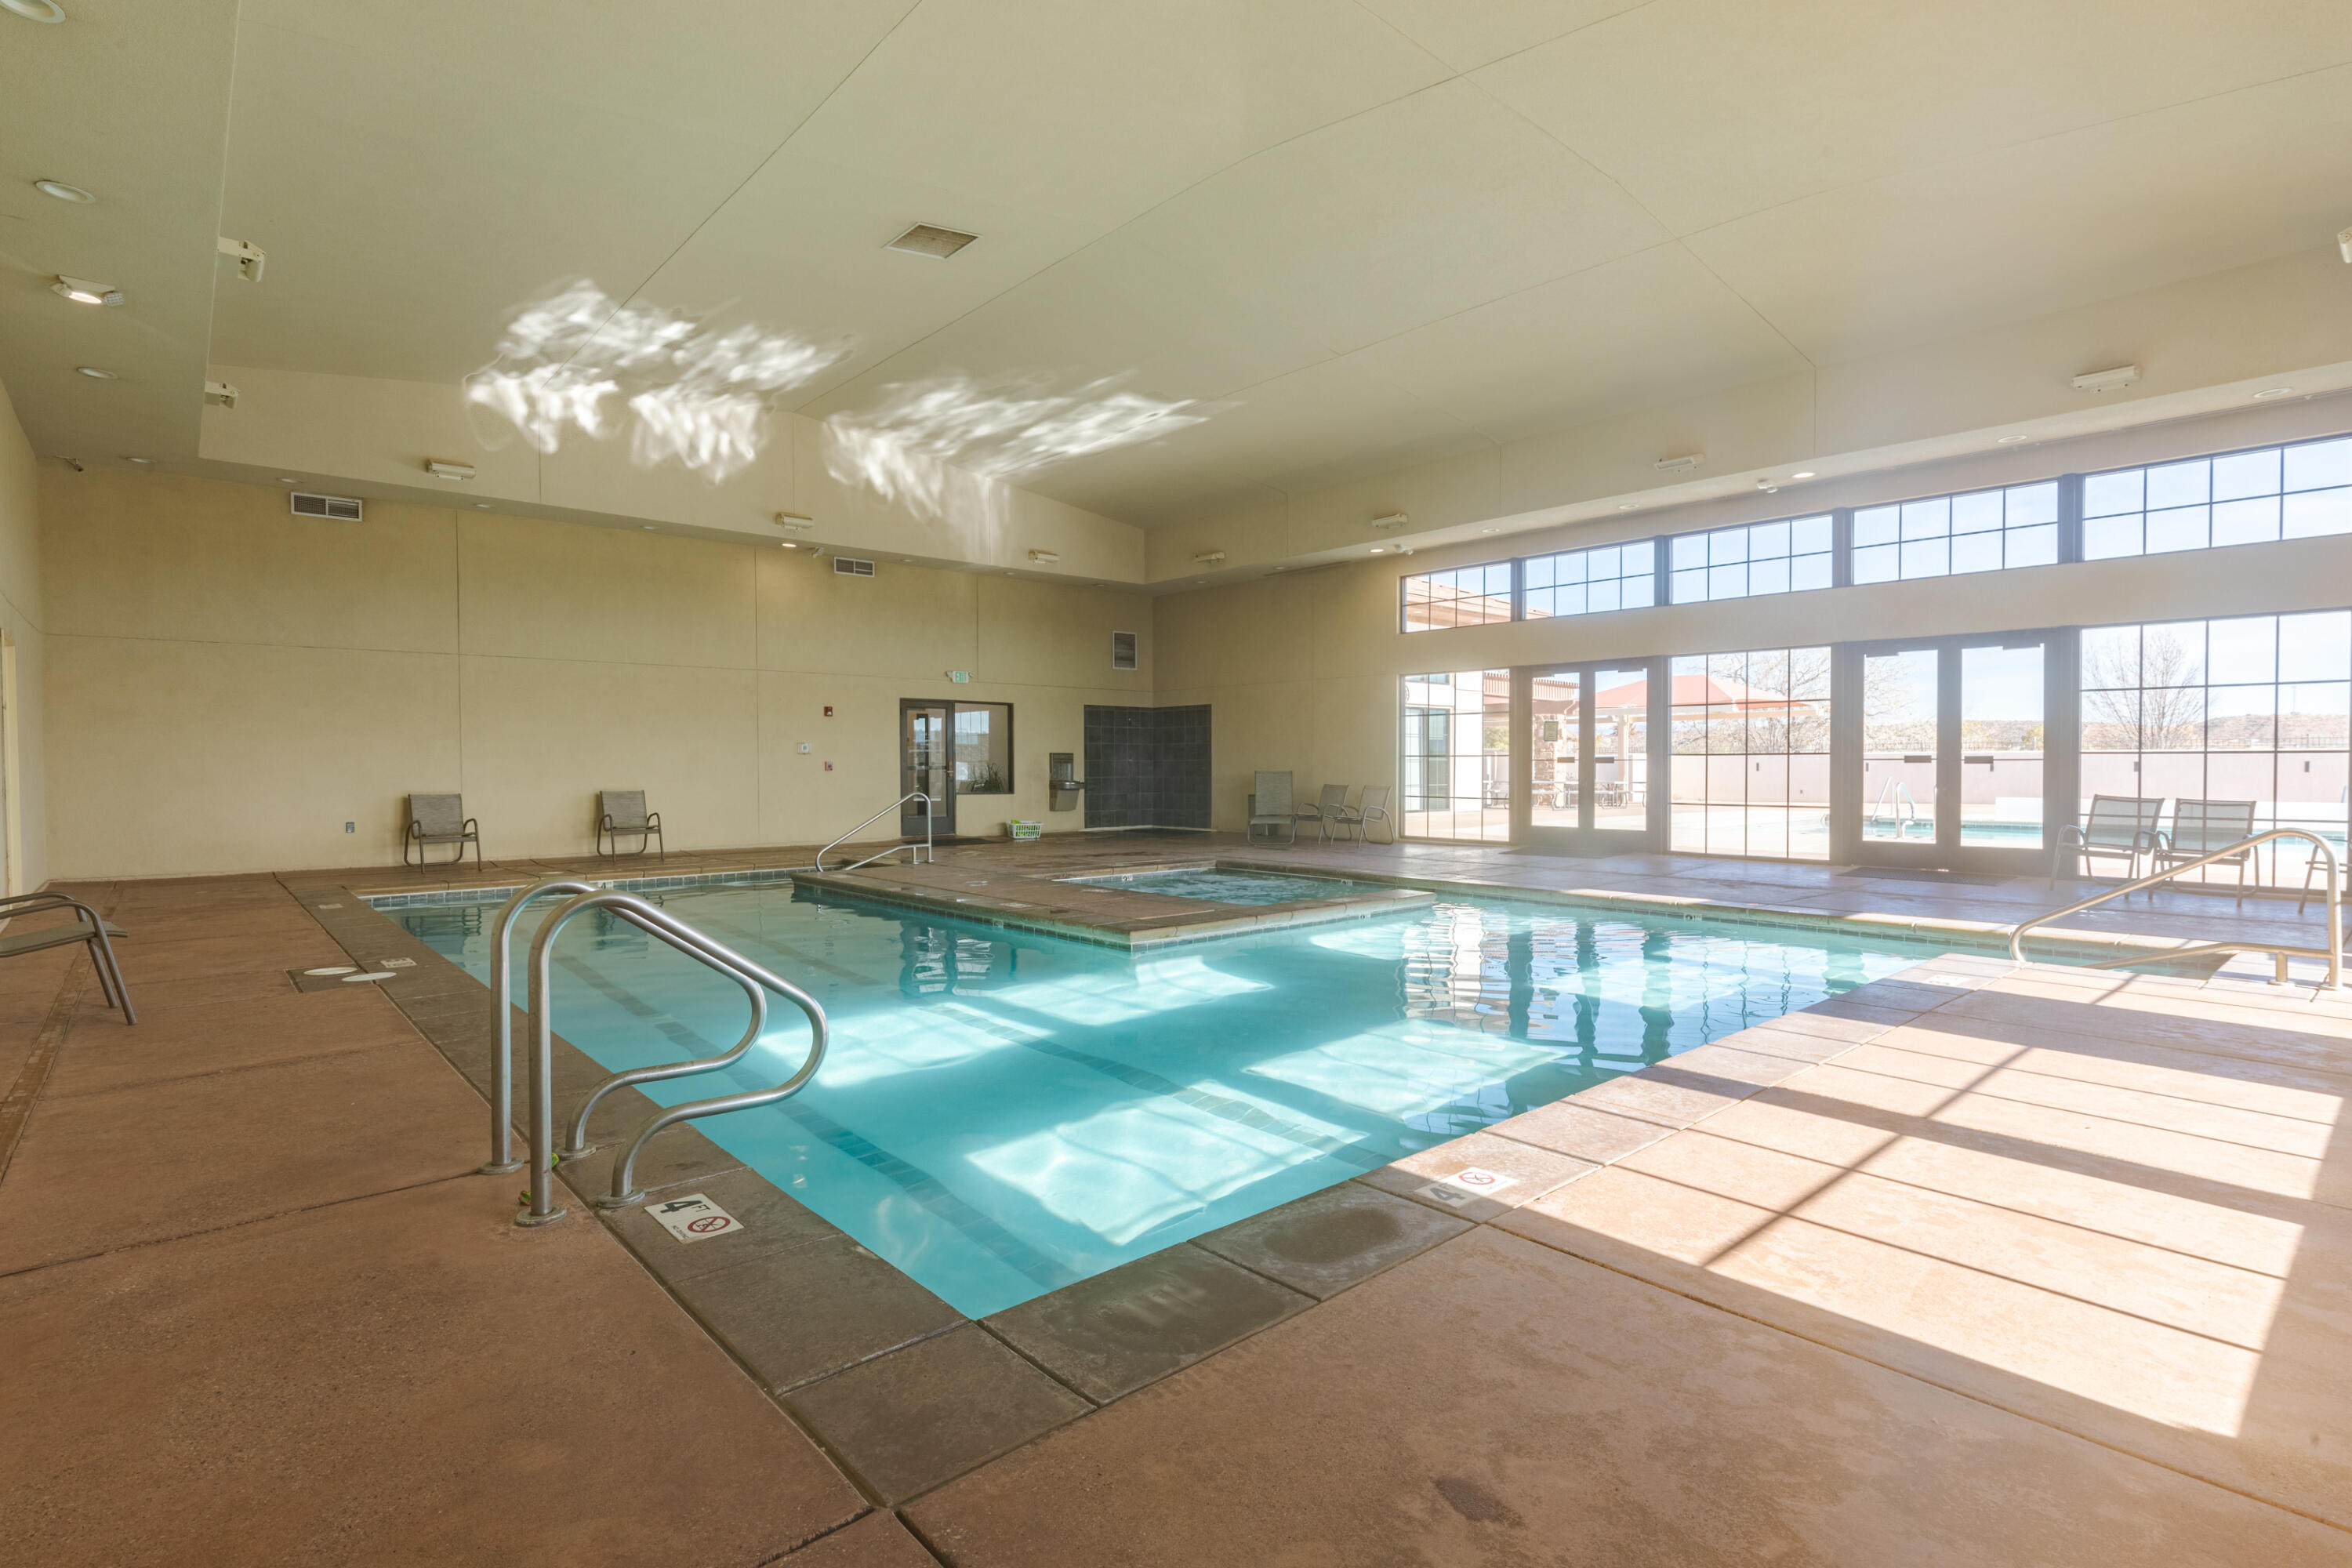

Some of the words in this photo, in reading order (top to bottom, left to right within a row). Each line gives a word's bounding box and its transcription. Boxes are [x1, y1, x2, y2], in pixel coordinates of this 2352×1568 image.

[955, 671, 967, 682] EXIT
[1429, 1187, 1465, 1200] 4
[660, 1200, 703, 1214] 4
[691, 1204, 711, 1213] FT
